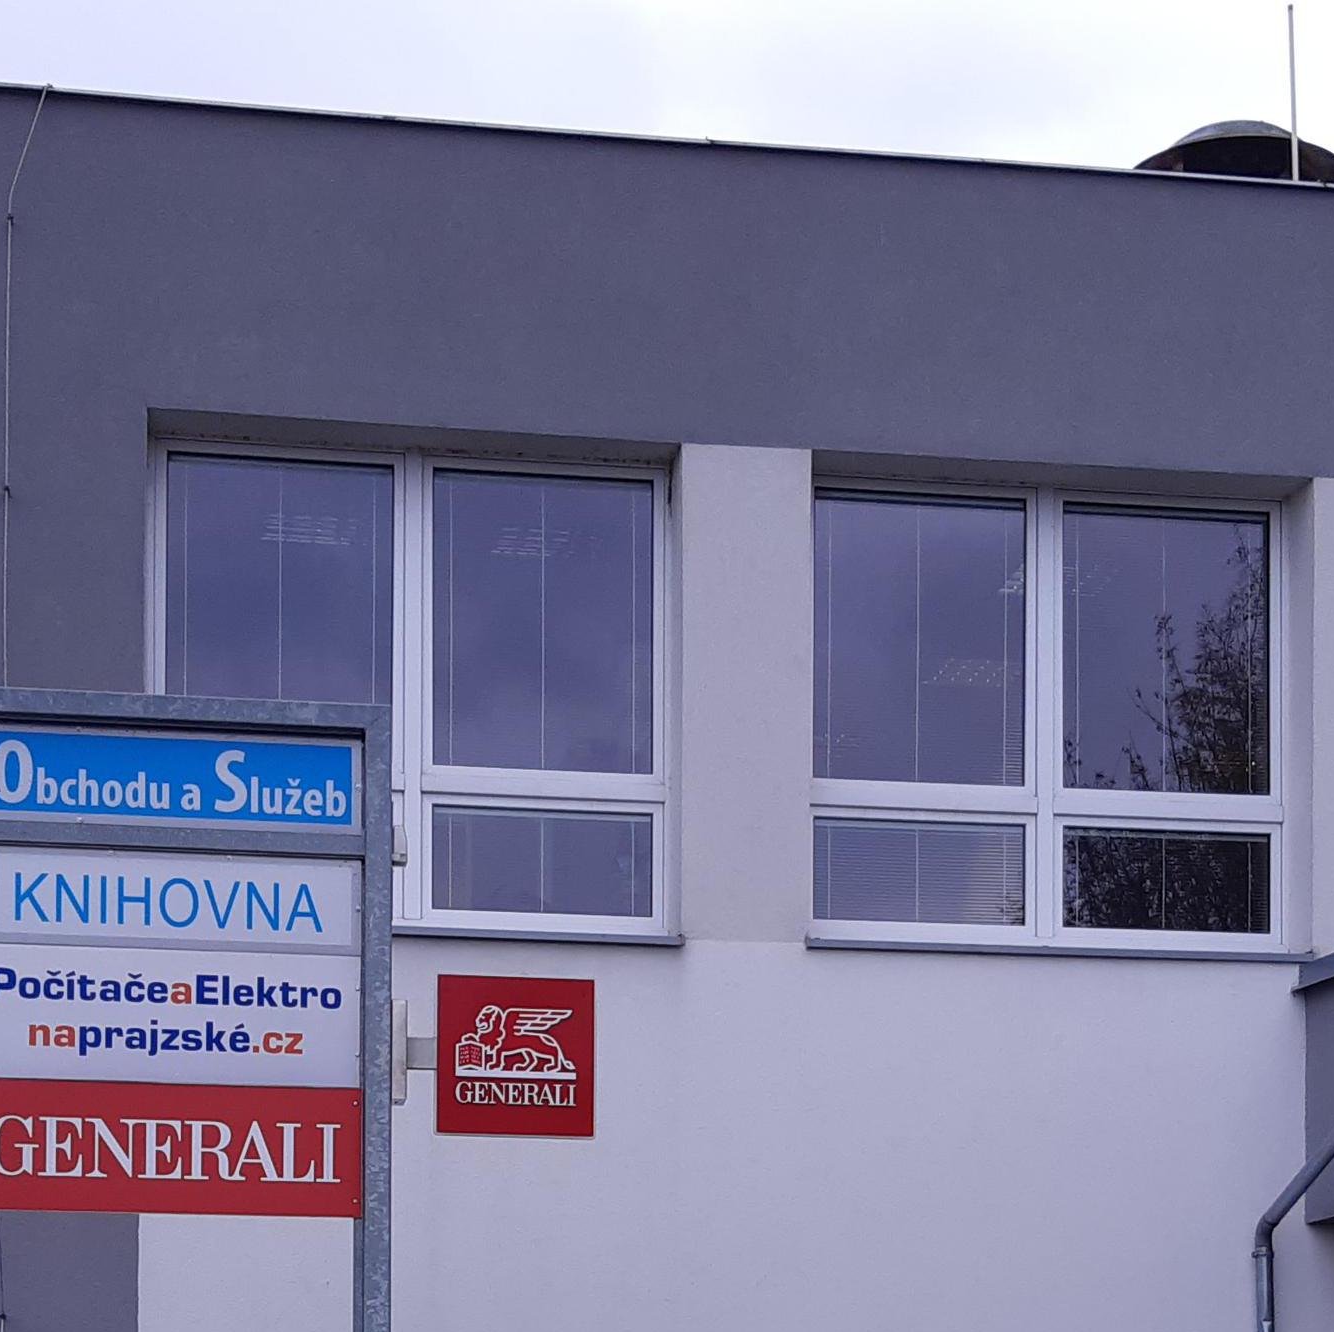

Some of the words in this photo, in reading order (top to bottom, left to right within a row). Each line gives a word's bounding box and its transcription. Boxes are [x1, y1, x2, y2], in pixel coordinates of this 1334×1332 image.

[180, 783, 201, 811] a
[214, 749, 347, 818] Služeb
[14, 872, 323, 932] KNIHOVNA
[28, 1019, 304, 1056] naprajzské.cz
[455, 1081, 577, 1107] GENERALI
